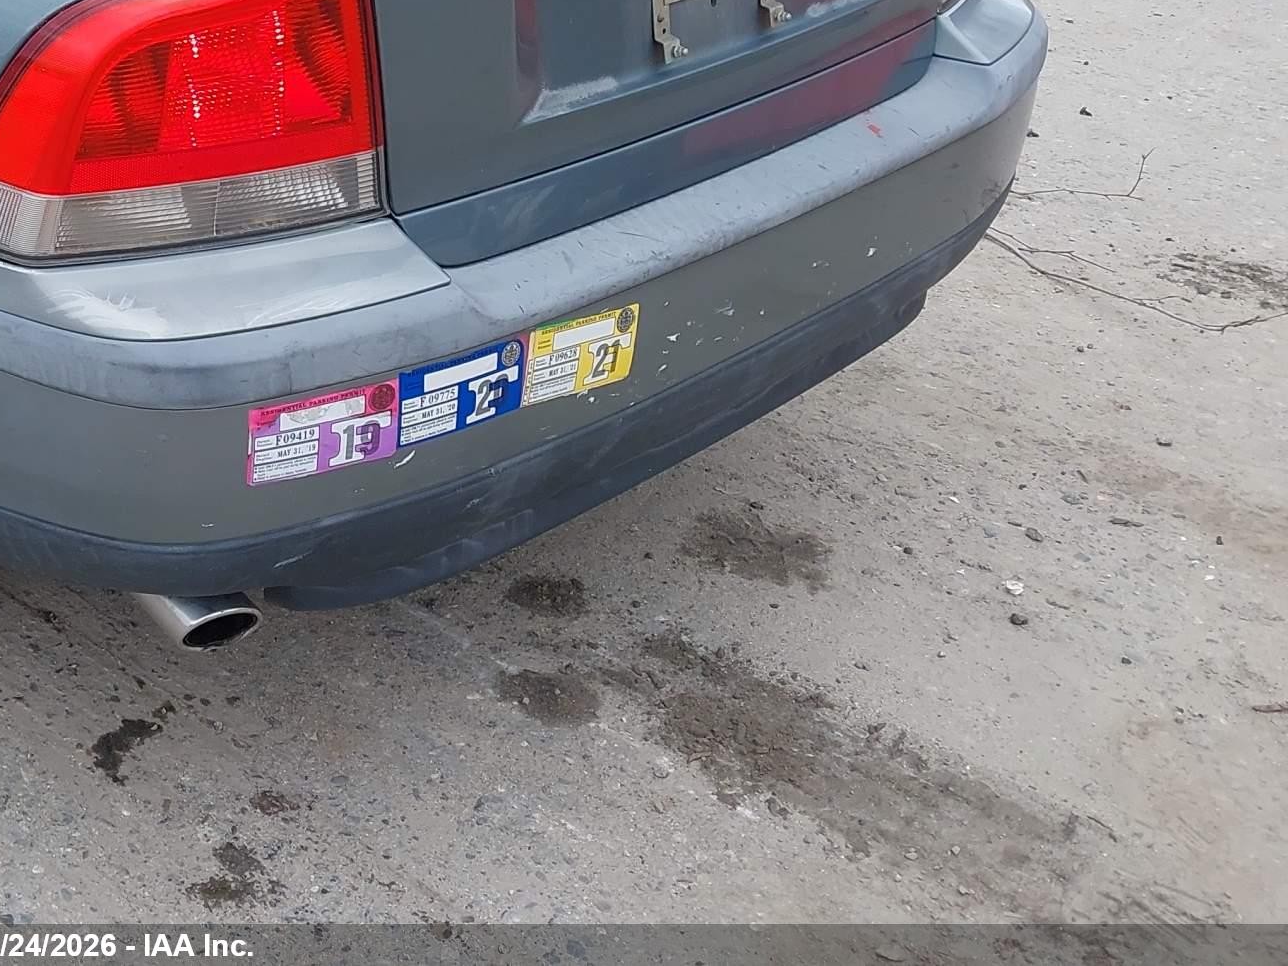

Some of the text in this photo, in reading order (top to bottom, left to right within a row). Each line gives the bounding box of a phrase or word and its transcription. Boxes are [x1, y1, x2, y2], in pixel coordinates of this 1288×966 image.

[421, 409, 435, 420] MAY
[275, 427, 316, 446] F09419
[277, 447, 291, 458] MAY
